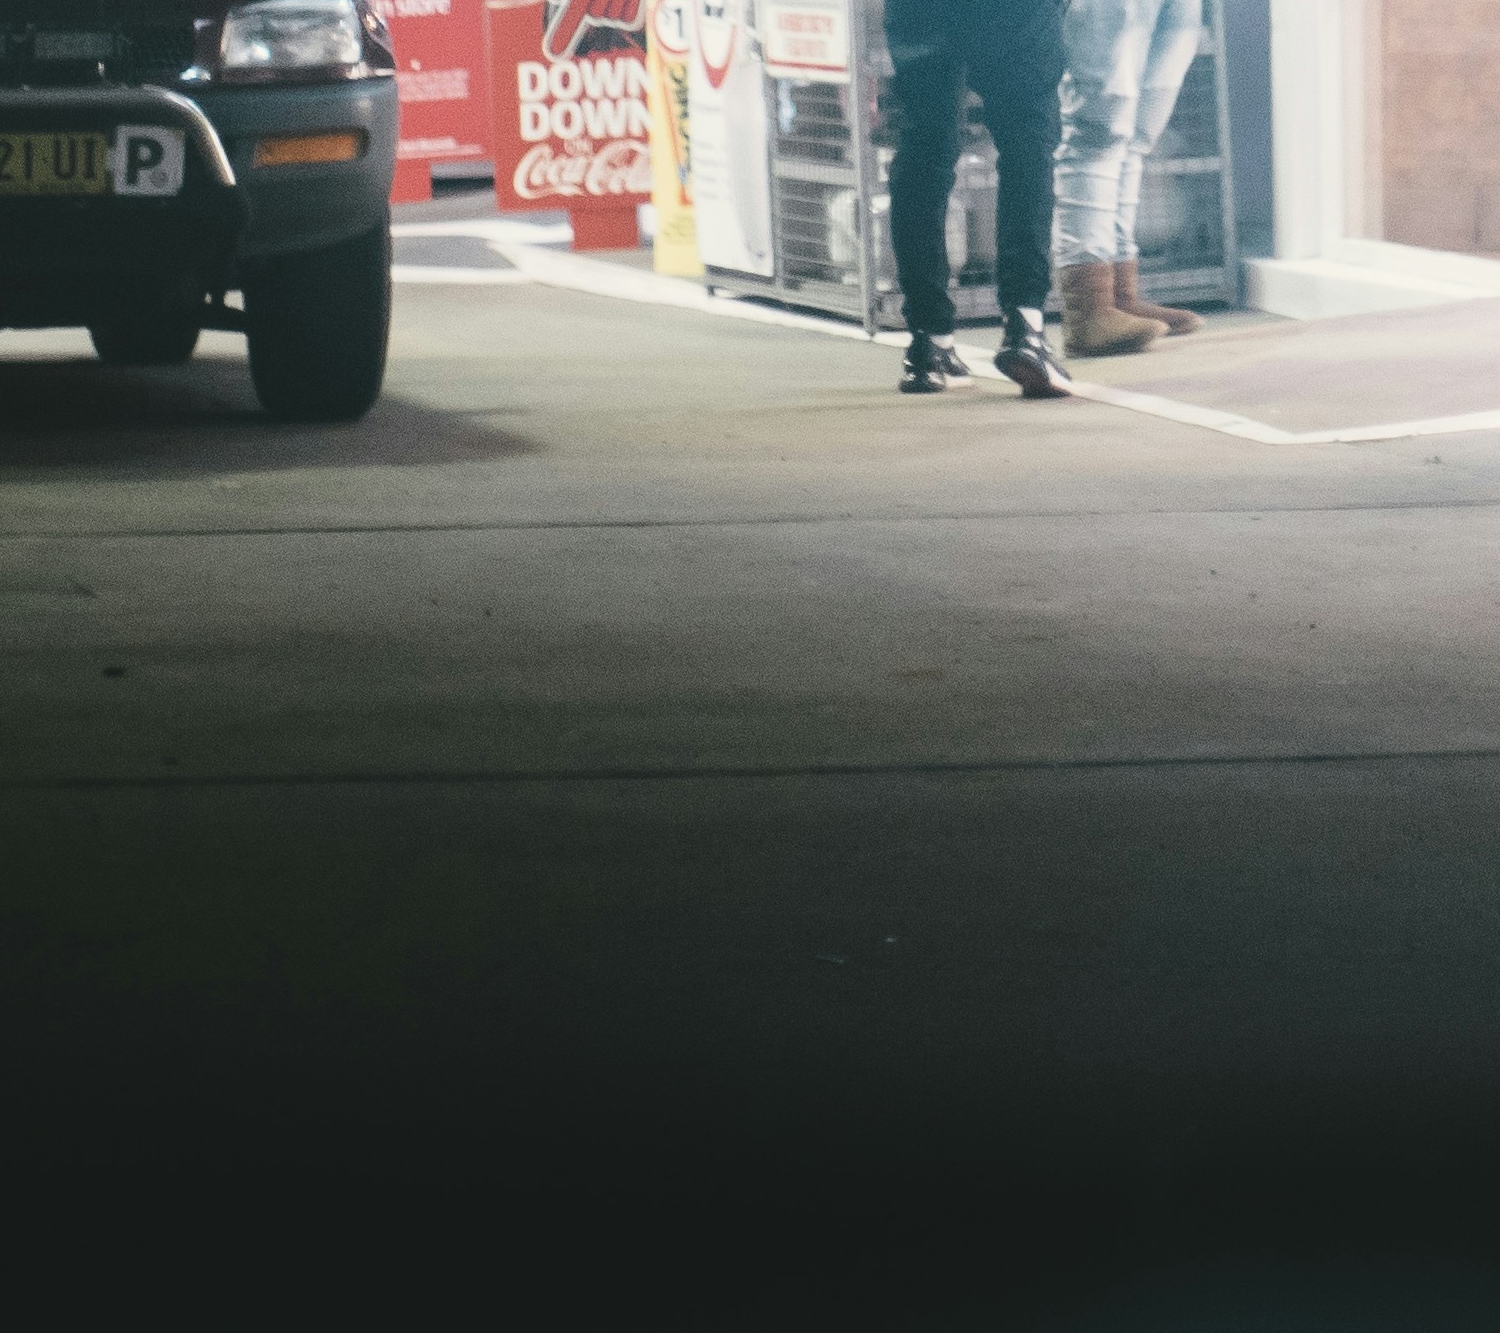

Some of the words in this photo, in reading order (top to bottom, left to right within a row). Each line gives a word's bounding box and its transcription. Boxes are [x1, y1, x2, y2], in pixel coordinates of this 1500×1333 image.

[518, 56, 655, 102] DOWN
[520, 97, 656, 142] DOWN
[51, 137, 97, 181] UI
[124, 135, 166, 187] P
